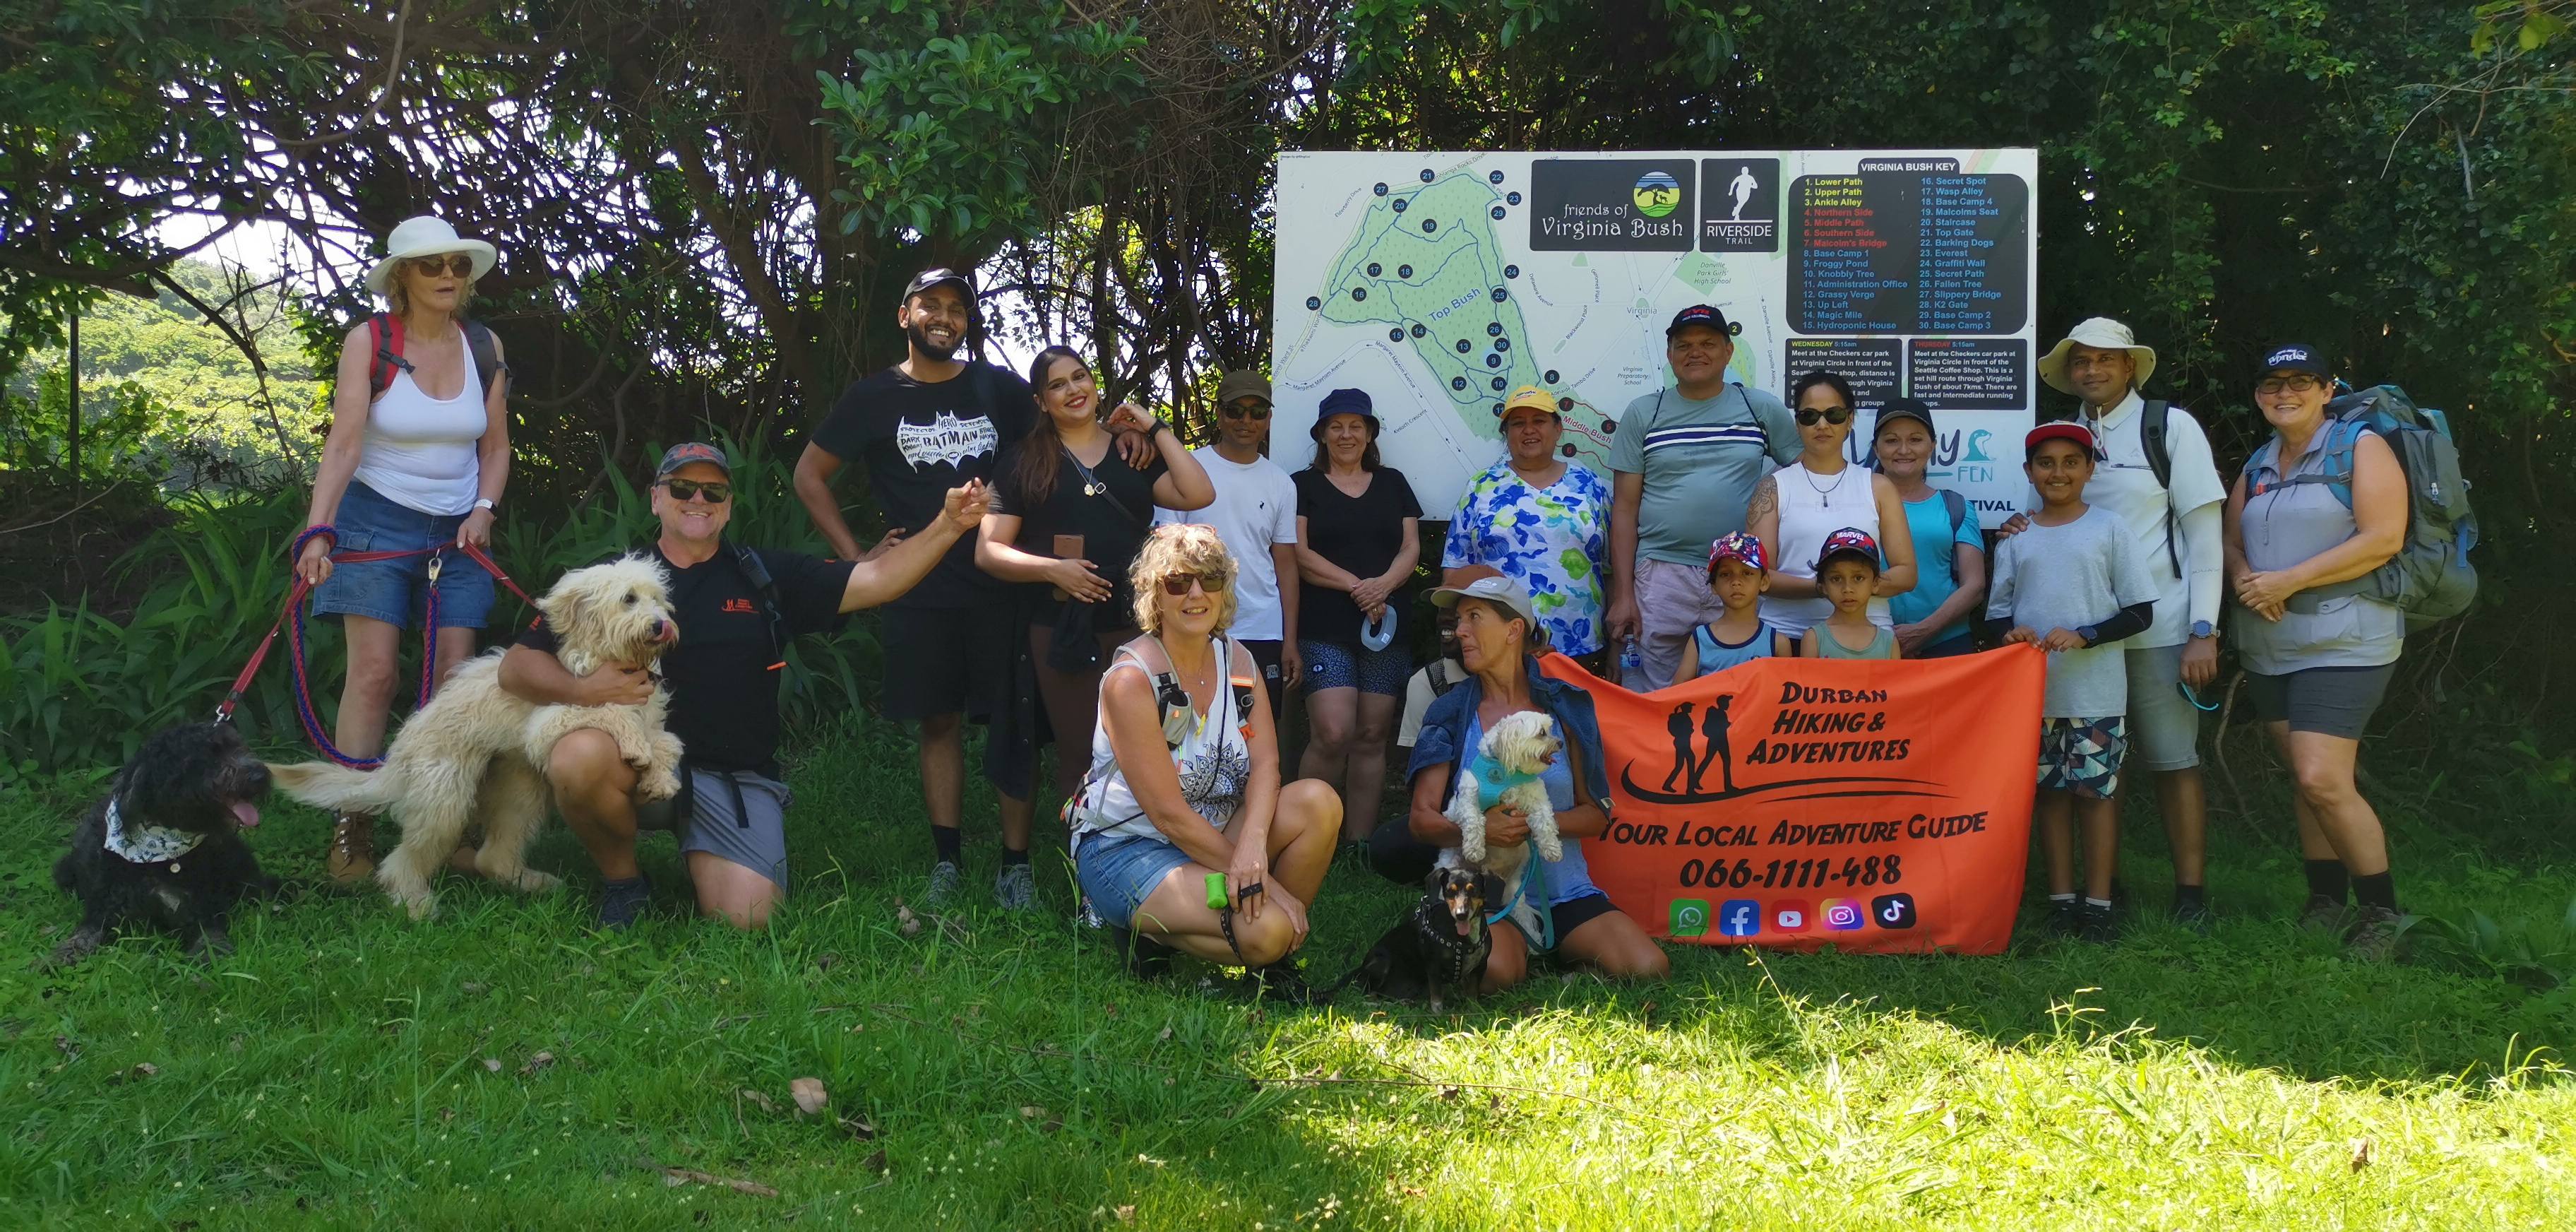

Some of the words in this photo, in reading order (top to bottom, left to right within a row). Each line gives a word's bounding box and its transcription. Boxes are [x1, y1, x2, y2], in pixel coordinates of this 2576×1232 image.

[1966, 177, 1986, 186] Spot
[1815, 189, 1841, 198] Upper
[1936, 187, 1960, 196] Wasp
[1962, 187, 1984, 196] Alley
[1840, 199, 1862, 208] Alley
[1564, 203, 1609, 218] friends
[1615, 204, 1628, 218] of
[1543, 215, 1621, 239] Virginia
[1631, 219, 1682, 237] Bush
[1707, 226, 1771, 236] RIVERSIDE
[1936, 239, 1969, 248] Barking
[1972, 239, 1993, 248] Dogs
[1837, 249, 1862, 259] Camp
[1813, 260, 1843, 269] Froggy
[1818, 270, 1854, 280] Knobbly
[1818, 290, 1848, 300] Grassy
[1850, 290, 1875, 300] Verge
[1934, 290, 1970, 300] Slippery
[1972, 290, 2001, 300] Bridge
[1429, 307, 1450, 321] Top
[1451, 288, 1481, 309] Bush
[1817, 321, 1866, 331] Hydroponic
[1958, 321, 1984, 331] Camp
[938, 417, 958, 430] HERO
[1563, 415, 1590, 432] Middle
[1590, 429, 1611, 444] Bush
[901, 437, 920, 445] DARK
[922, 430, 979, 449] BATMAN
[1957, 466, 1993, 482] FEN
[1969, 500, 2015, 511] TIVAL
[1837, 531, 1864, 540] MARVEL
[1779, 682, 1887, 704] DURBAN
[1772, 709, 1865, 734] HIKING
[1867, 712, 1885, 732] &
[1746, 739, 1910, 764] ADVENTURES
[1676, 822, 1758, 847] LOCAL
[1768, 820, 1902, 846] ADVENTURE
[1907, 812, 1987, 839] GUIDE
[1680, 855, 1901, 888] 066-1111-488
